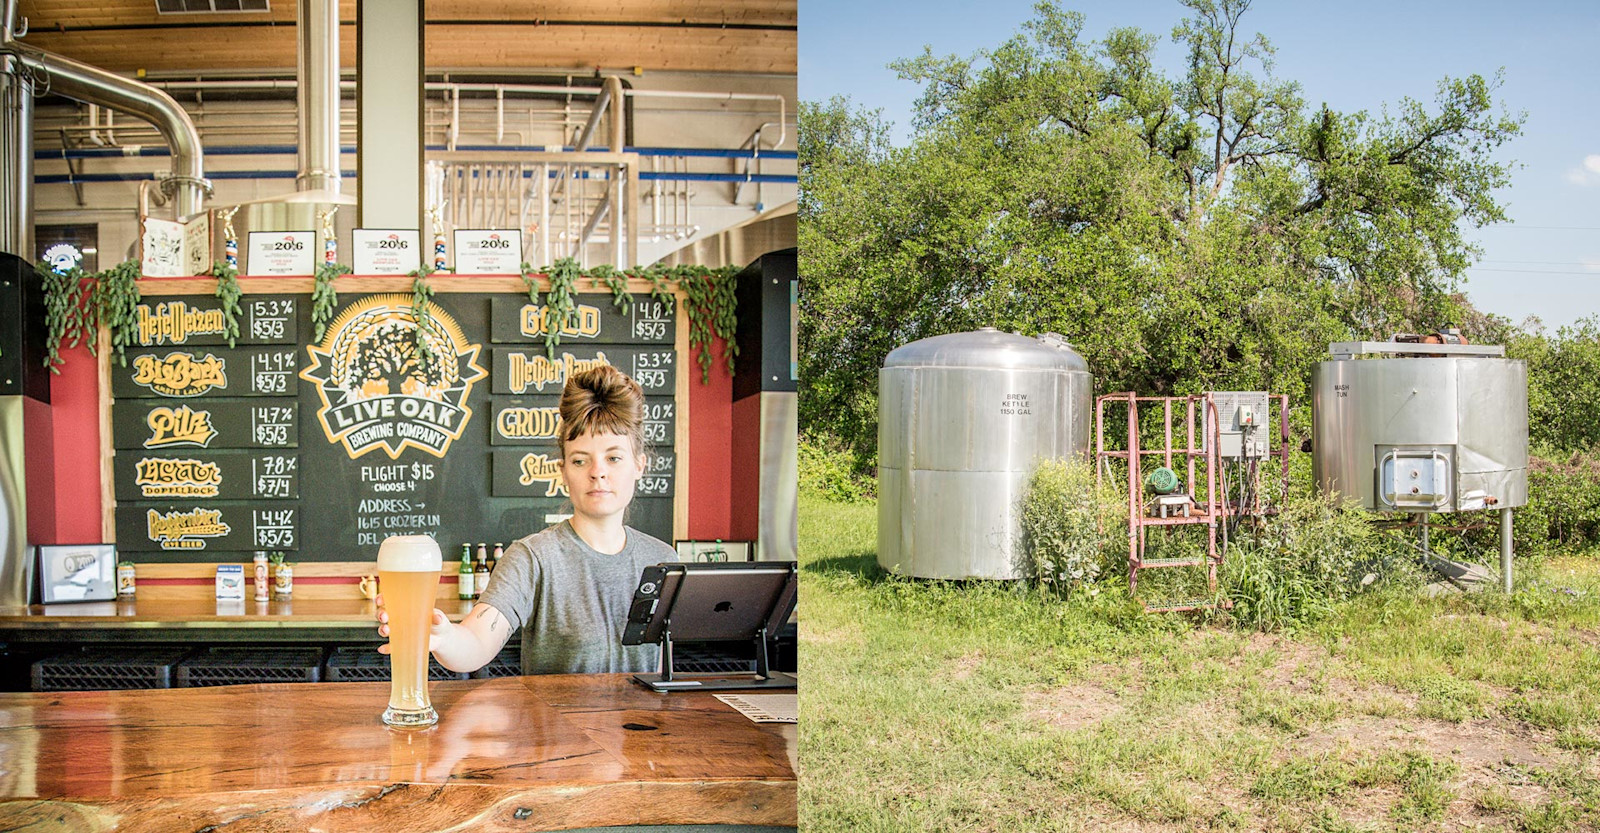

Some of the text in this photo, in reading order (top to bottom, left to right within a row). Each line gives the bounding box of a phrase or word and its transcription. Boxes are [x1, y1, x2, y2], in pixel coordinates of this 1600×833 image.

[255, 300, 293, 317] 5.3%
[254, 320, 285, 339] $5/3
[636, 321, 666, 339] $5/3
[258, 353, 295, 371] 4.9%
[638, 353, 672, 368] 5.3%
[256, 374, 286, 392] $5/3
[636, 372, 666, 388] $5/3
[258, 407, 292, 424] 4.7%
[334, 398, 456, 428] LIVE OAK
[499, 409, 562, 437] GRODZ
[256, 426, 287, 444] $5/3
[349, 422, 446, 448] BREWING COMPANY
[643, 424, 666, 441] 5/3
[262, 456, 296, 475] 7.8%
[361, 461, 435, 482] FLIGHT $15
[145, 486, 215, 495] DOPPELBOCK
[258, 478, 289, 497] $7/4
[374, 480, 415, 492] CHOOSE 4
[637, 478, 668, 494] $5/3
[358, 499, 412, 513] ADDRESS
[261, 510, 294, 527] 4.4%
[358, 514, 441, 529] 1615 CROZIER LN
[258, 530, 294, 547] $5/3
[358, 532, 380, 546] DEL
